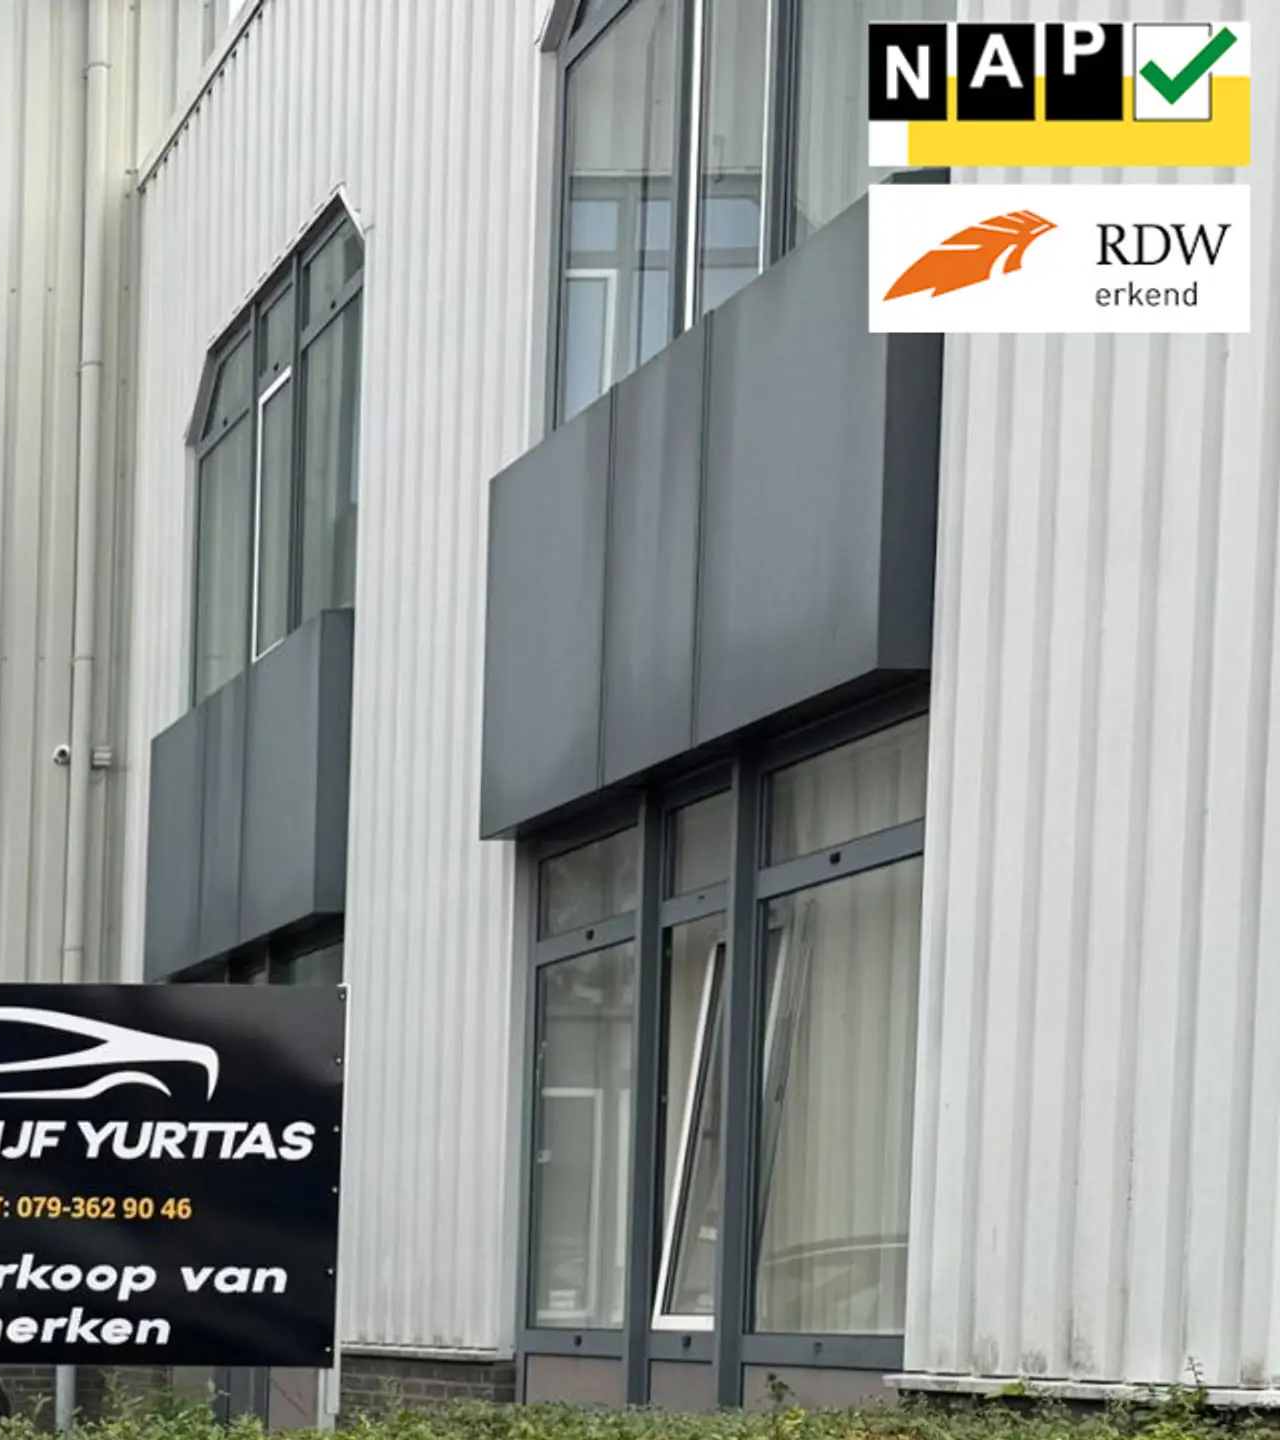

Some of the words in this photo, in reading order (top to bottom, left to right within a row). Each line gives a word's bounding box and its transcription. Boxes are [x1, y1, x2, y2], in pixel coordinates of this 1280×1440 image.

[77, 1120, 317, 1161] YURTTAS
[16, 1195, 116, 1219] 079-362
[122, 1197, 154, 1219] 90
[160, 1197, 193, 1220] 46
[181, 1267, 289, 1294] van
